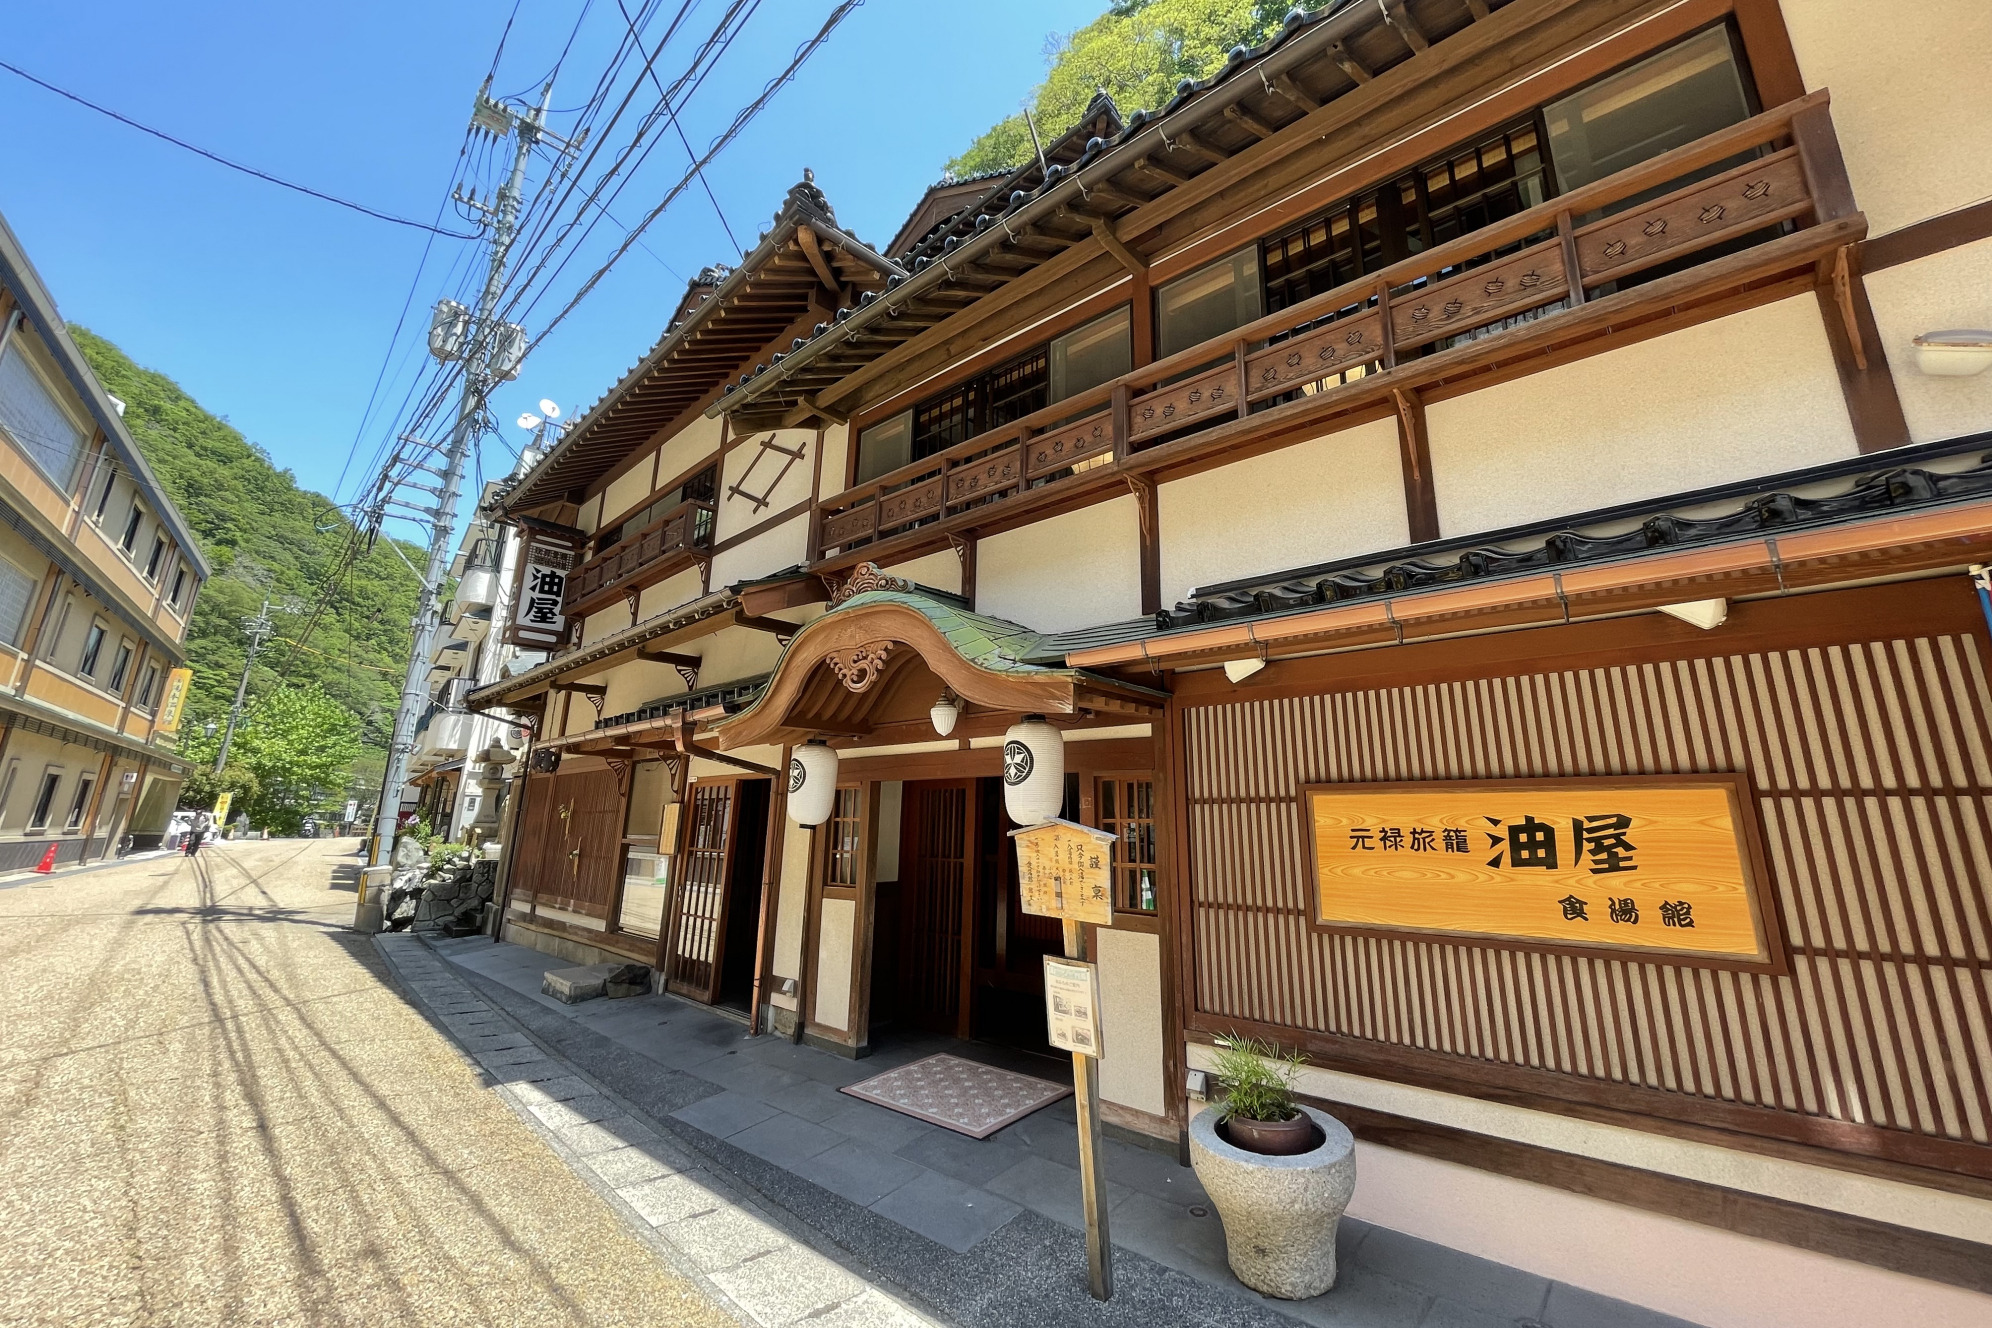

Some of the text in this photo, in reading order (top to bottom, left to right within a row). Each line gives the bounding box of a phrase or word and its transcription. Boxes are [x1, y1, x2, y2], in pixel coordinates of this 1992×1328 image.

[523, 566, 564, 624] 油屋
[1349, 813, 1639, 875] 元禄旅籠 油屋
[1556, 894, 1696, 929] 食湯館
